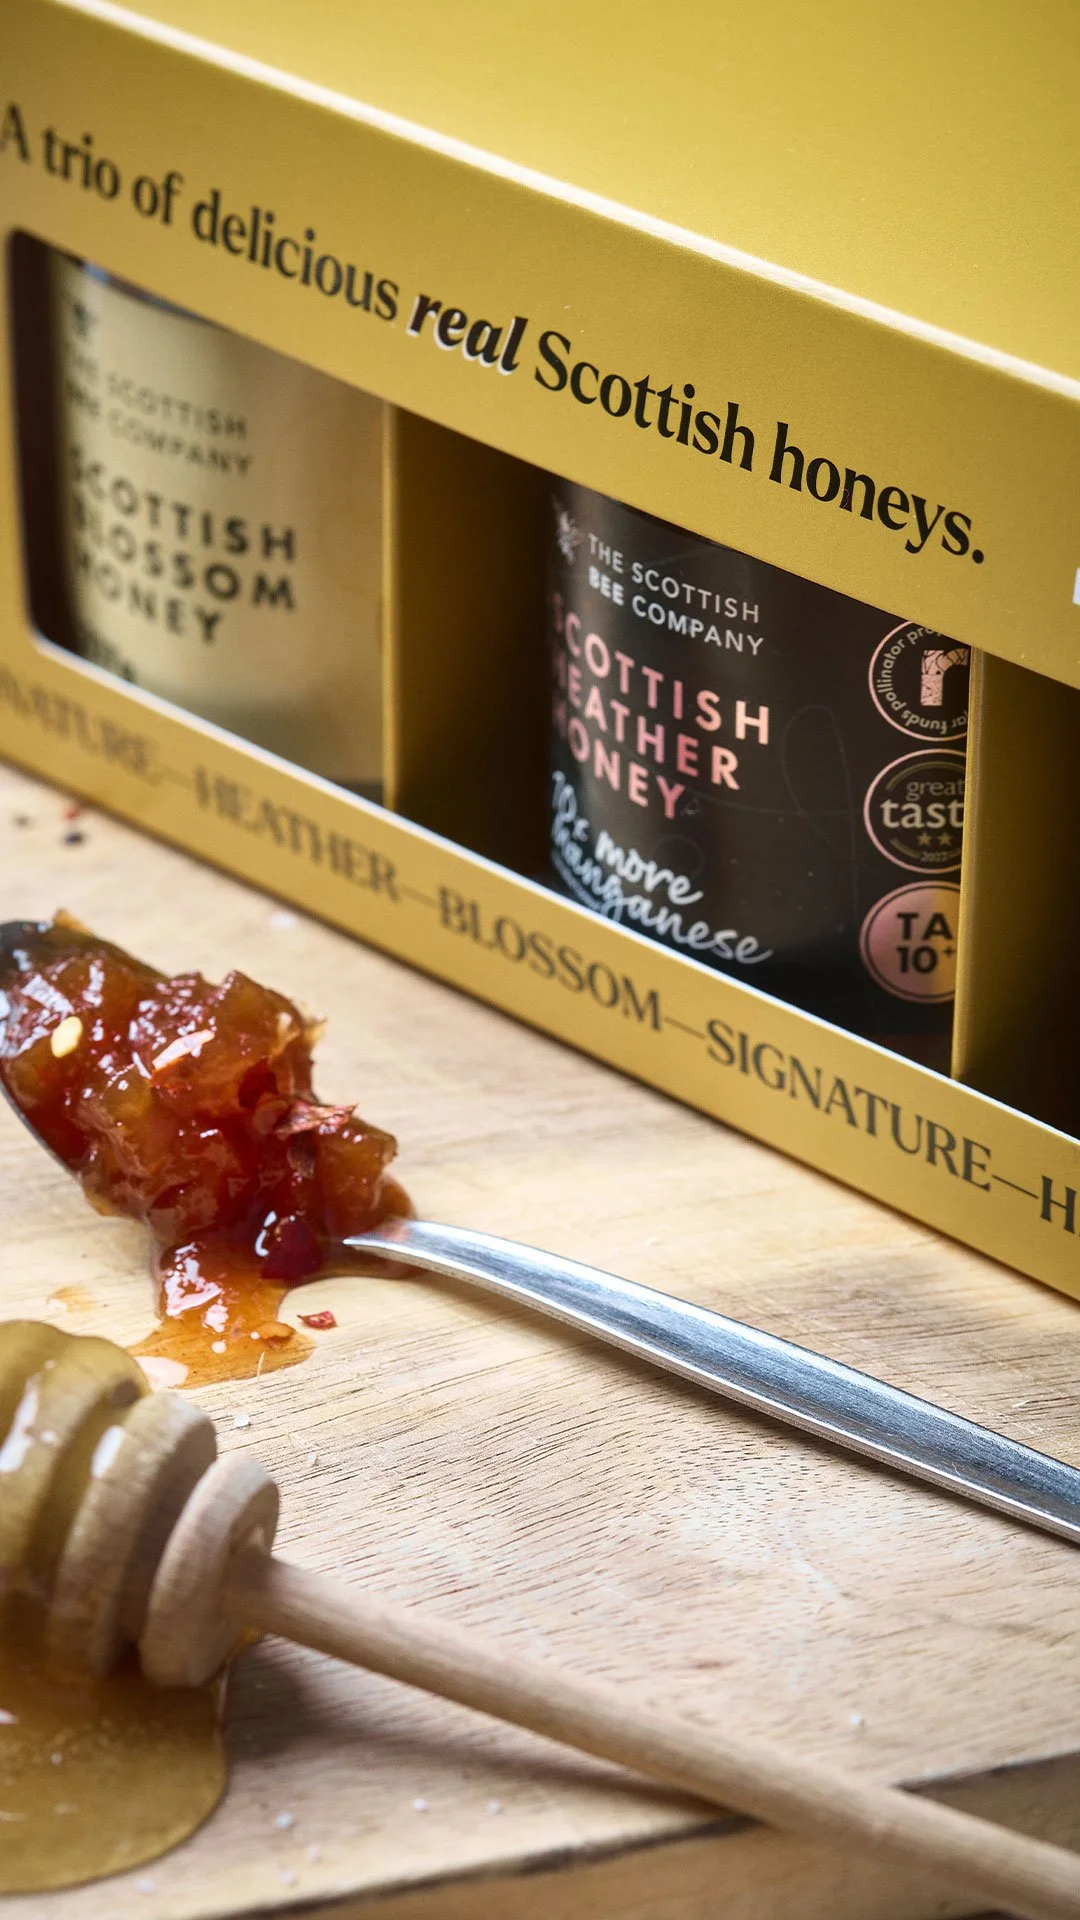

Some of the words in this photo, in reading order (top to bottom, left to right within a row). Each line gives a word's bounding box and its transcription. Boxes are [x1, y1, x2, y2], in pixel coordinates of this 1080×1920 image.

[0, 102, 30, 164] A
[43, 127, 120, 201] trio
[133, 172, 182, 226] of
[192, 190, 399, 322] delicious
[407, 293, 528, 376] real
[534, 329, 755, 472] Scottish
[768, 421, 986, 565] honeys.
[105, 370, 249, 442] SCOTTISH
[106, 405, 254, 476] COMPANY
[588, 532, 624, 574] THE
[631, 561, 760, 624] SCOTTISH
[588, 565, 625, 606] BEE
[631, 595, 765, 656] COMPANY
[876, 638, 907, 712] pollinator
[900, 709, 948, 735] funds
[906, 778, 968, 802] great
[551, 815, 775, 965] manganese
[594, 830, 705, 905] more
[896, 912, 953, 941] TA
[438, 886, 664, 1033] BLOSSOM
[705, 1019, 993, 1193] SIGNATURE
